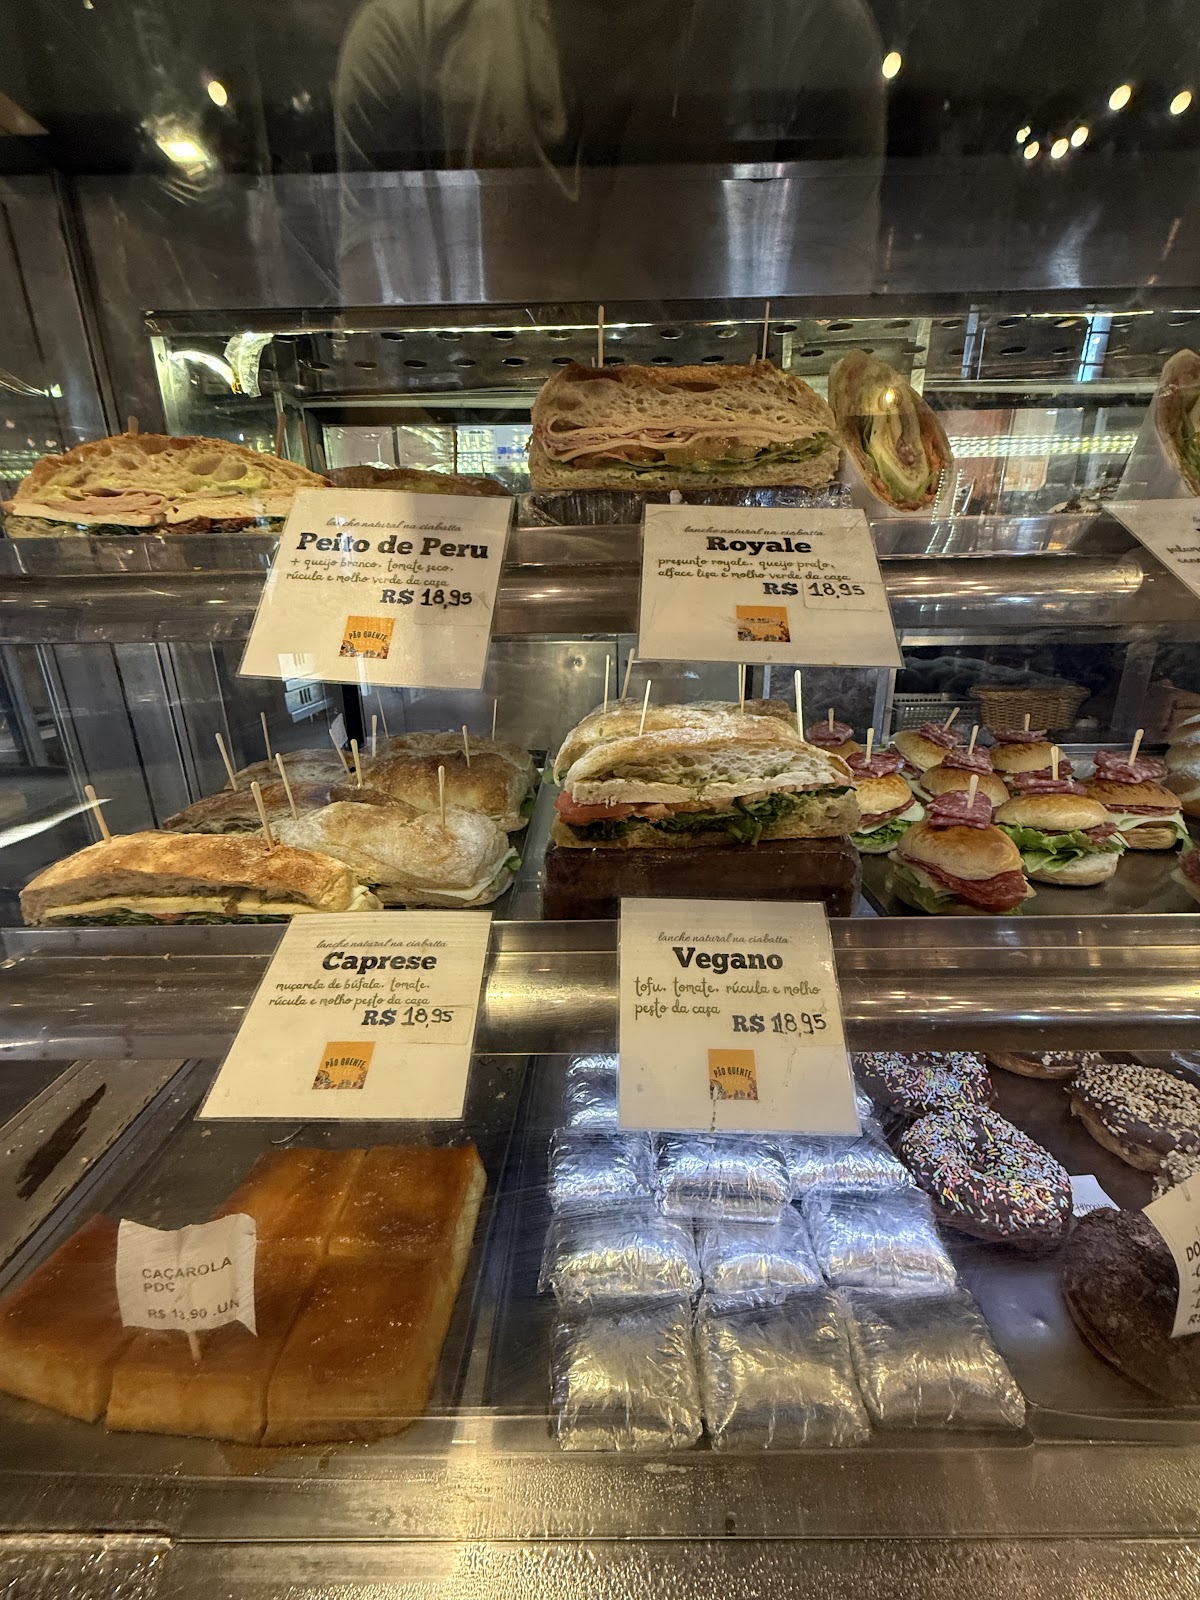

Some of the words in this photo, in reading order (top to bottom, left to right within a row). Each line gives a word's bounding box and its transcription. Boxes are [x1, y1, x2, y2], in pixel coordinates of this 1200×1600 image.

[361, 520, 401, 529] natural
[419, 522, 462, 531] ciabatta
[296, 532, 370, 553] Peito
[377, 534, 413, 555] de
[420, 537, 489, 559] Peru
[706, 535, 812, 556] Royale
[304, 558, 338, 571] queijo
[387, 558, 424, 573] tomate
[657, 555, 707, 570] presunto
[759, 559, 794, 571] queijo
[286, 571, 323, 582] rúcula
[336, 572, 370, 583] molho
[372, 575, 403, 585] verde
[406, 576, 421, 585] da
[423, 578, 450, 588] casa
[657, 568, 694, 579] alface
[696, 569, 719, 579] lisa
[731, 569, 765, 579] molho
[769, 571, 801, 580] verde
[804, 572, 822, 581] da
[824, 574, 851, 582] casa
[763, 582, 799, 596] R$
[380, 588, 414, 606] R$
[420, 588, 473, 609] 18,95
[316, 939, 350, 949] lanche
[350, 939, 391, 948] natural
[406, 939, 448, 948] ciabatta
[658, 932, 692, 942] lanche
[692, 932, 731, 943] natural
[748, 934, 789, 944] ciabatta
[322, 951, 437, 974] Caprese
[672, 947, 783, 974] Vegano
[276, 979, 325, 991] muçarela
[328, 978, 342, 990] de
[725, 981, 770, 994] rúcula
[773, 986, 780, 994] e
[784, 981, 821, 995] molho
[268, 995, 308, 1006] rúcula
[319, 994, 353, 1005] molho
[353, 993, 385, 1010] pesto
[387, 994, 402, 1005] da
[404, 998, 430, 1007] casa
[635, 998, 668, 1020] pesto
[672, 999, 690, 1014] da
[692, 1004, 720, 1017] casa
[361, 1008, 397, 1027] R$
[401, 1007, 455, 1028] 18,95
[732, 1014, 766, 1034] R$
[713, 1066, 725, 1078] PÃO
[727, 1066, 752, 1078] QUENTE
[142, 1256, 232, 1280] CAÇAROLA
[143, 1282, 175, 1293] PDÇ
[148, 1308, 166, 1319] R$
